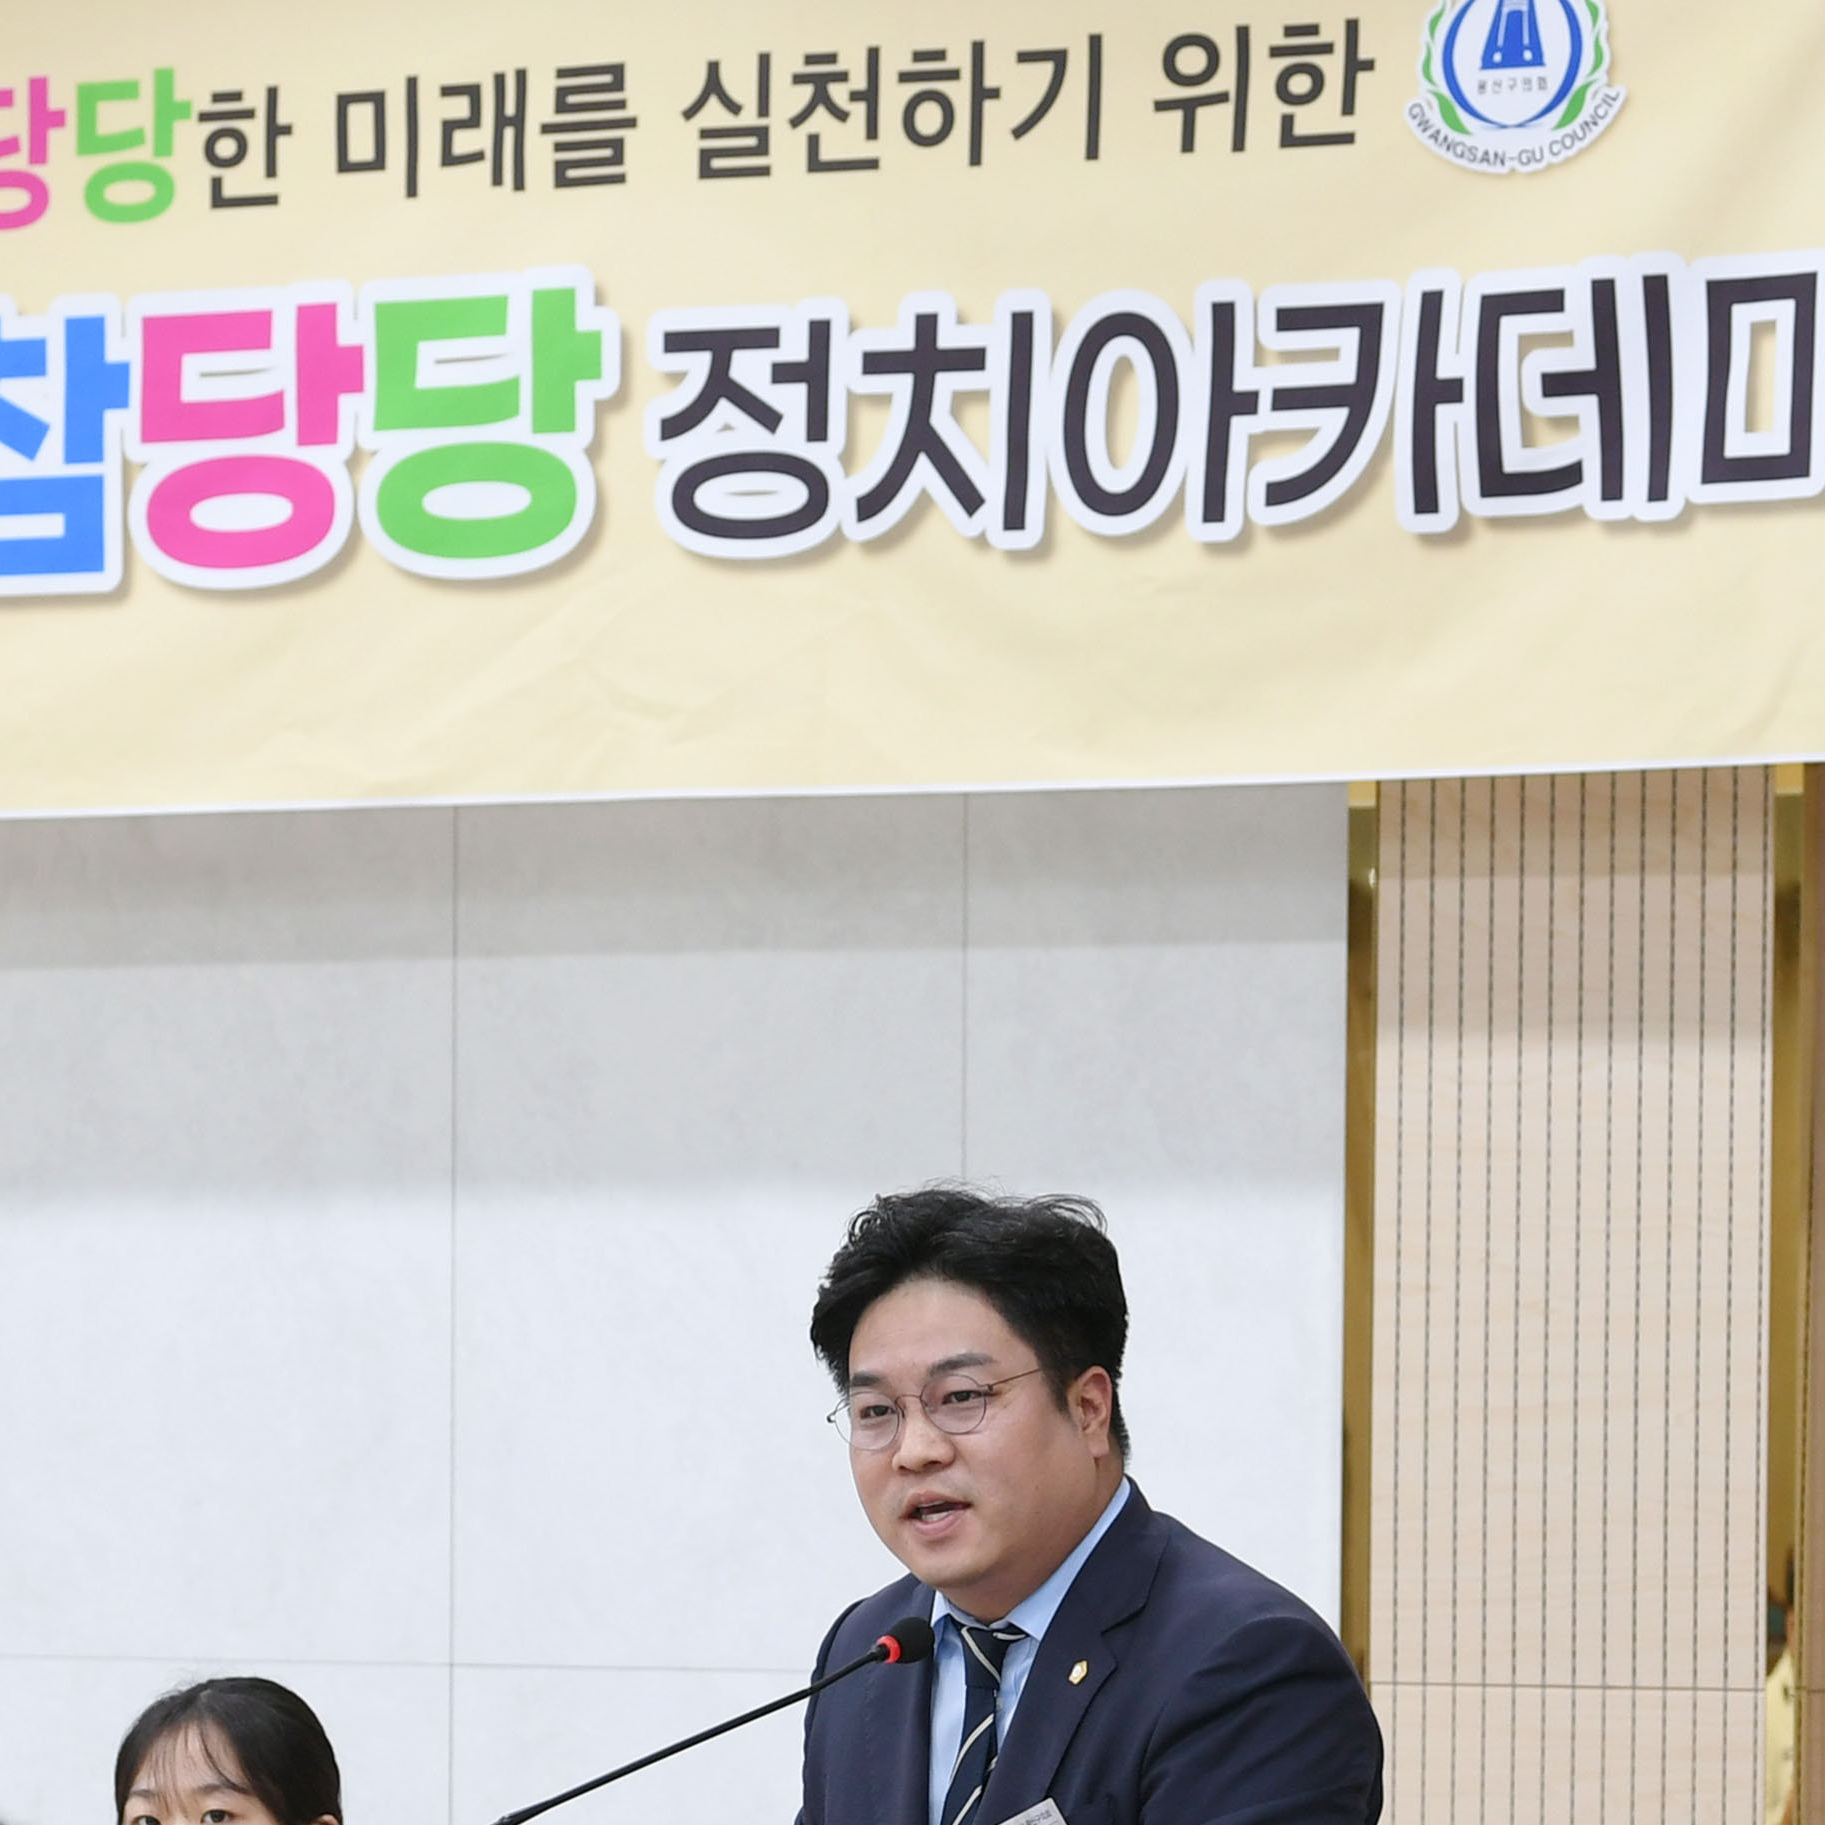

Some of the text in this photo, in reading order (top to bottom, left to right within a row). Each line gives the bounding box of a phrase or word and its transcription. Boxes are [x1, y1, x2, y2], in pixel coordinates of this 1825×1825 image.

[334, 61, 638, 199] 미래를
[680, 33, 1103, 181] 실천하기
[1152, 17, 1376, 155] 위한
[1407, 89, 1621, 168] GWANGSAN-GU COUNCIL
